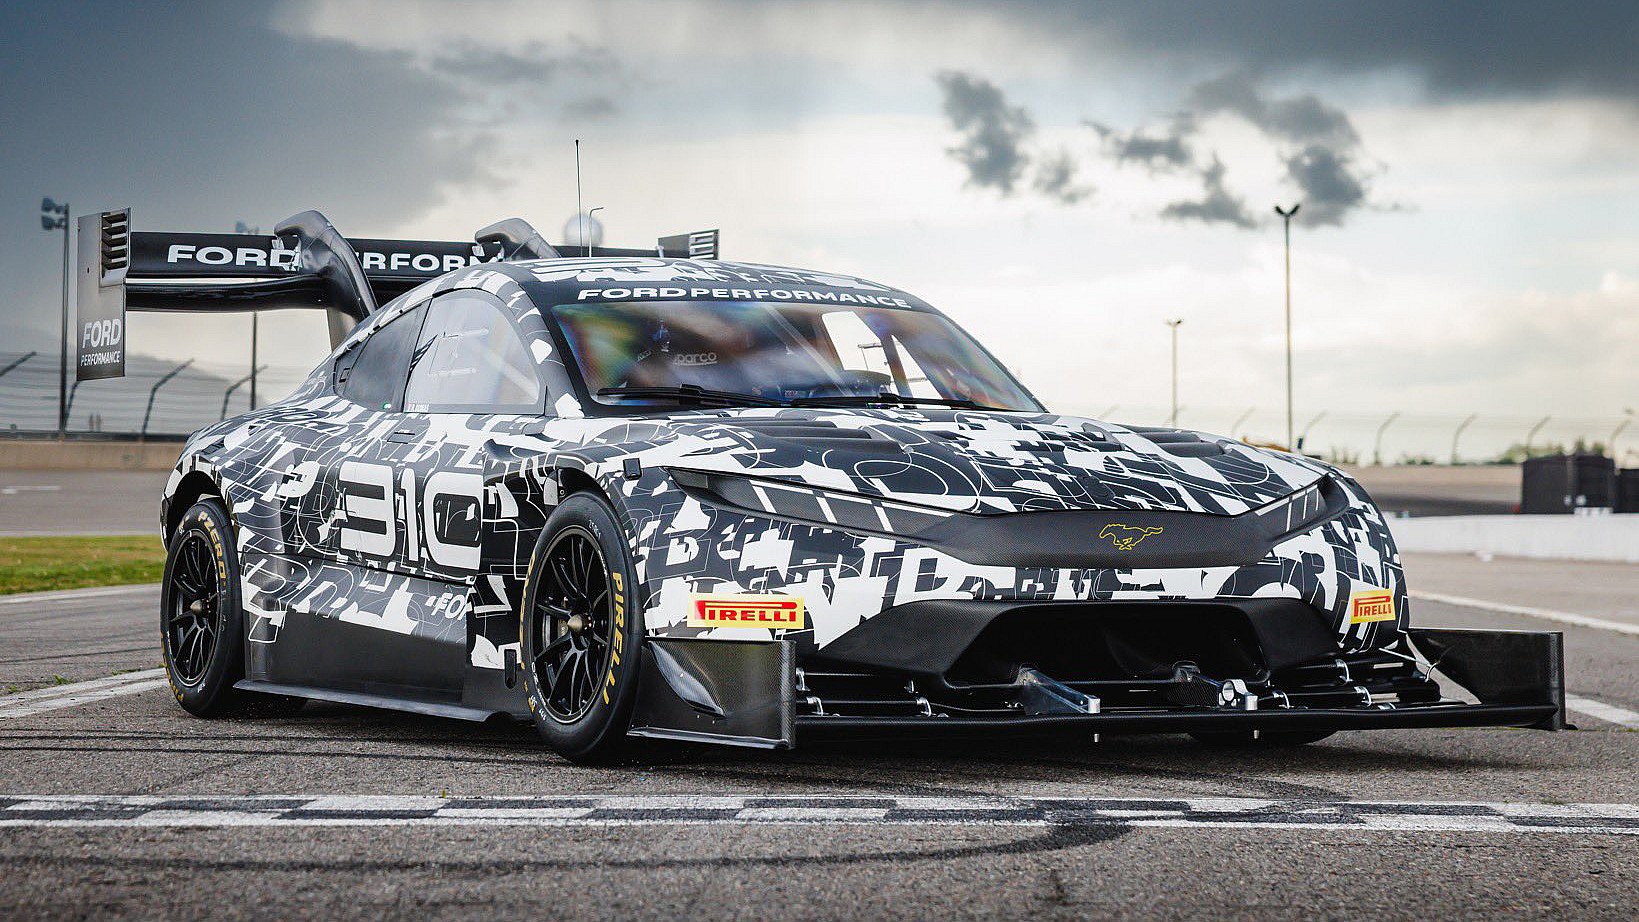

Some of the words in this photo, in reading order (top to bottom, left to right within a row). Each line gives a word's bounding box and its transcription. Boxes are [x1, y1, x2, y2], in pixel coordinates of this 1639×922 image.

[167, 244, 300, 268] FORD
[82, 319, 121, 349] FORD
[80, 350, 121, 367] PERFORMANCE
[339, 461, 484, 571] 310
[695, 599, 798, 622] PIRELLI
[1353, 595, 1392, 617] PIRELLI
[604, 571, 625, 705] PIRELLI
